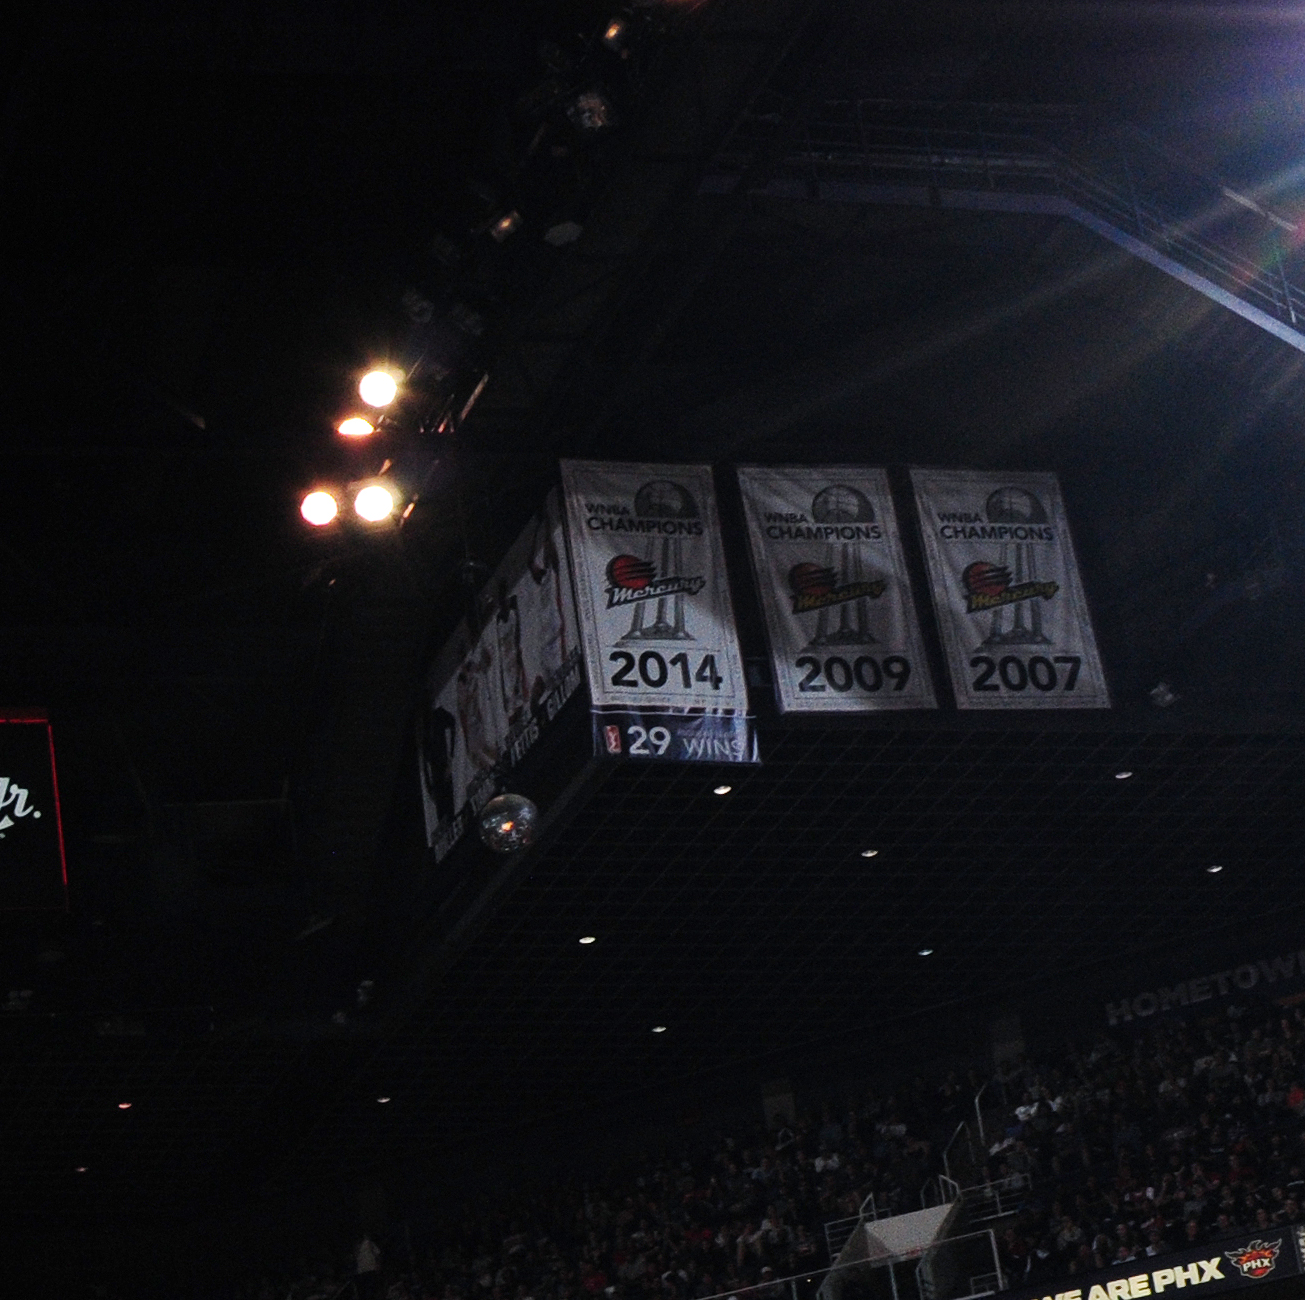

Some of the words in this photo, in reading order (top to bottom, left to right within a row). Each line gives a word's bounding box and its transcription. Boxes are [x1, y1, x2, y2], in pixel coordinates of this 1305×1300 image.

[587, 517, 703, 536] CHAMPIONS
[766, 525, 882, 540] CHAMPIONS
[940, 525, 1054, 541] CHAMPIONS
[609, 650, 723, 690] 2014
[795, 655, 911, 692] 2009
[969, 655, 1081, 692] 2007
[627, 725, 672, 756] 29
[682, 736, 747, 757] WINS
[1104, 951, 1305, 1026] HOMETOW
[1242, 1257, 1271, 1272] PHX
